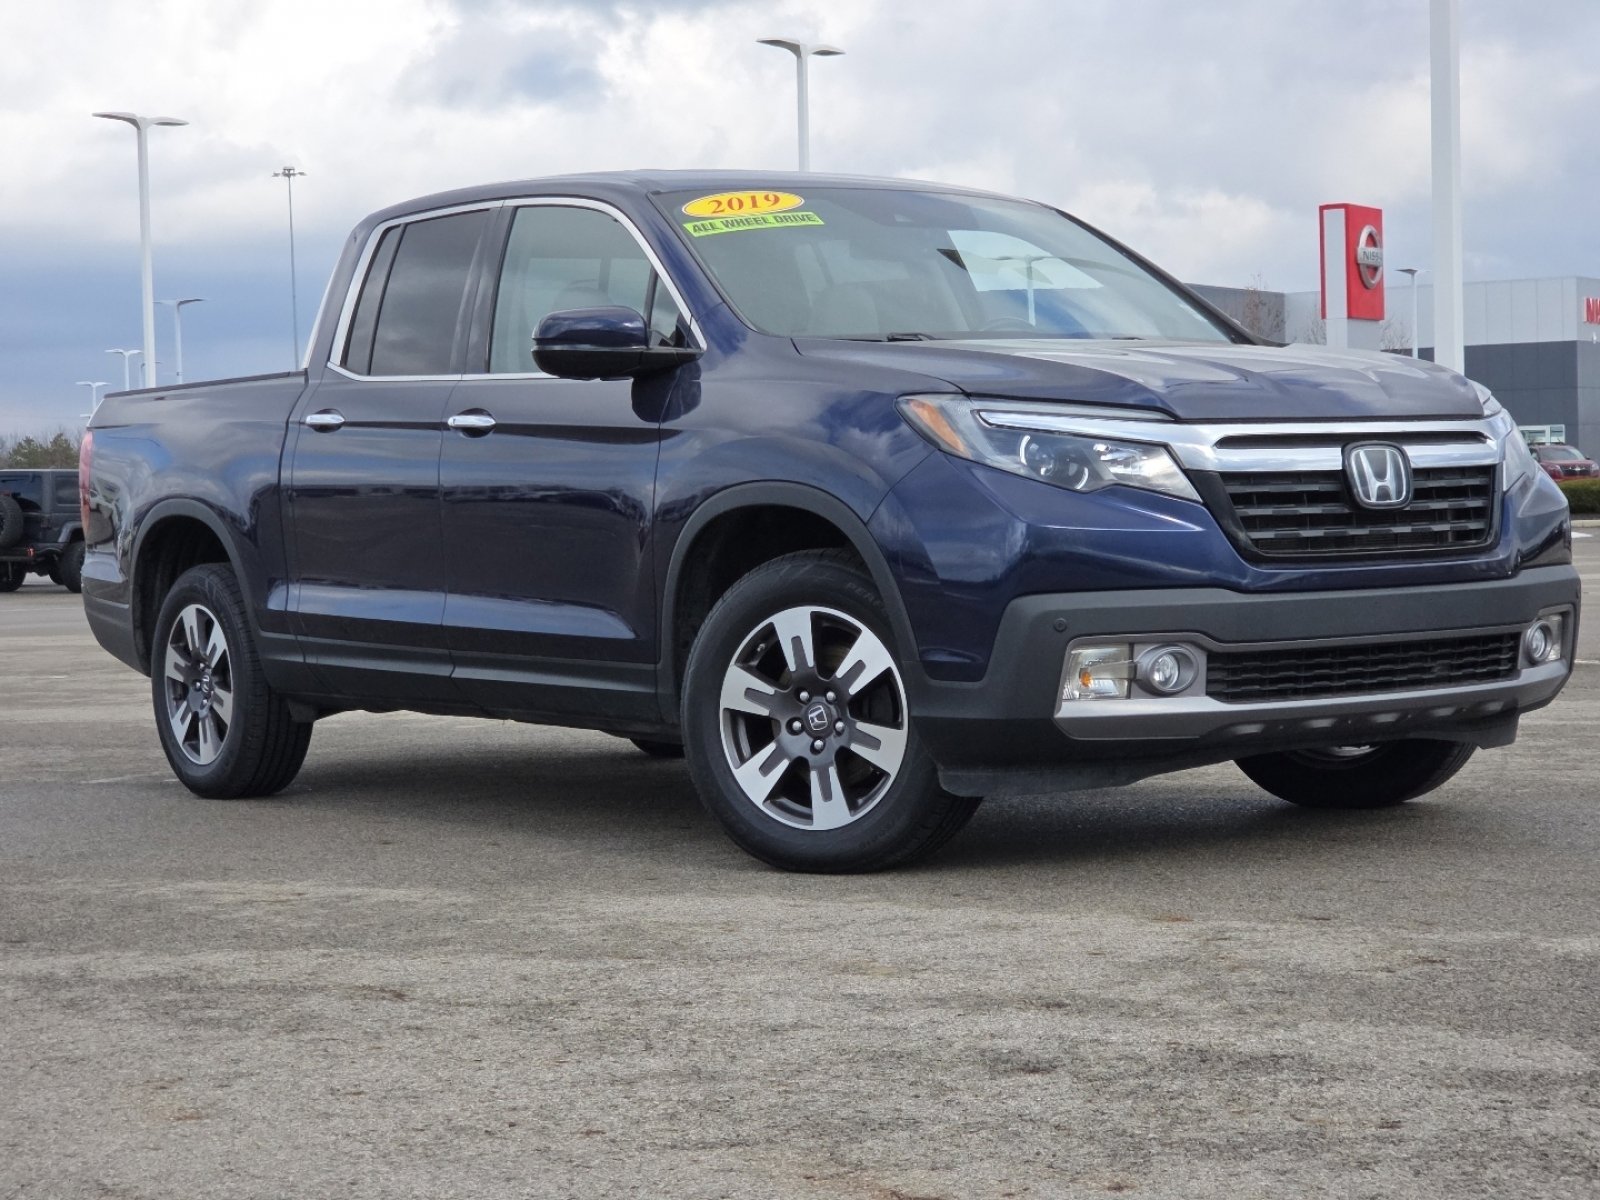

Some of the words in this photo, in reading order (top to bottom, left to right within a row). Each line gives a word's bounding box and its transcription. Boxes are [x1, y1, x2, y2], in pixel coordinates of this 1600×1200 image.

[708, 194, 780, 214] 2019
[692, 220, 720, 233] ALL
[722, 215, 770, 230] WHEEL
[774, 213, 816, 225] DRIVE
